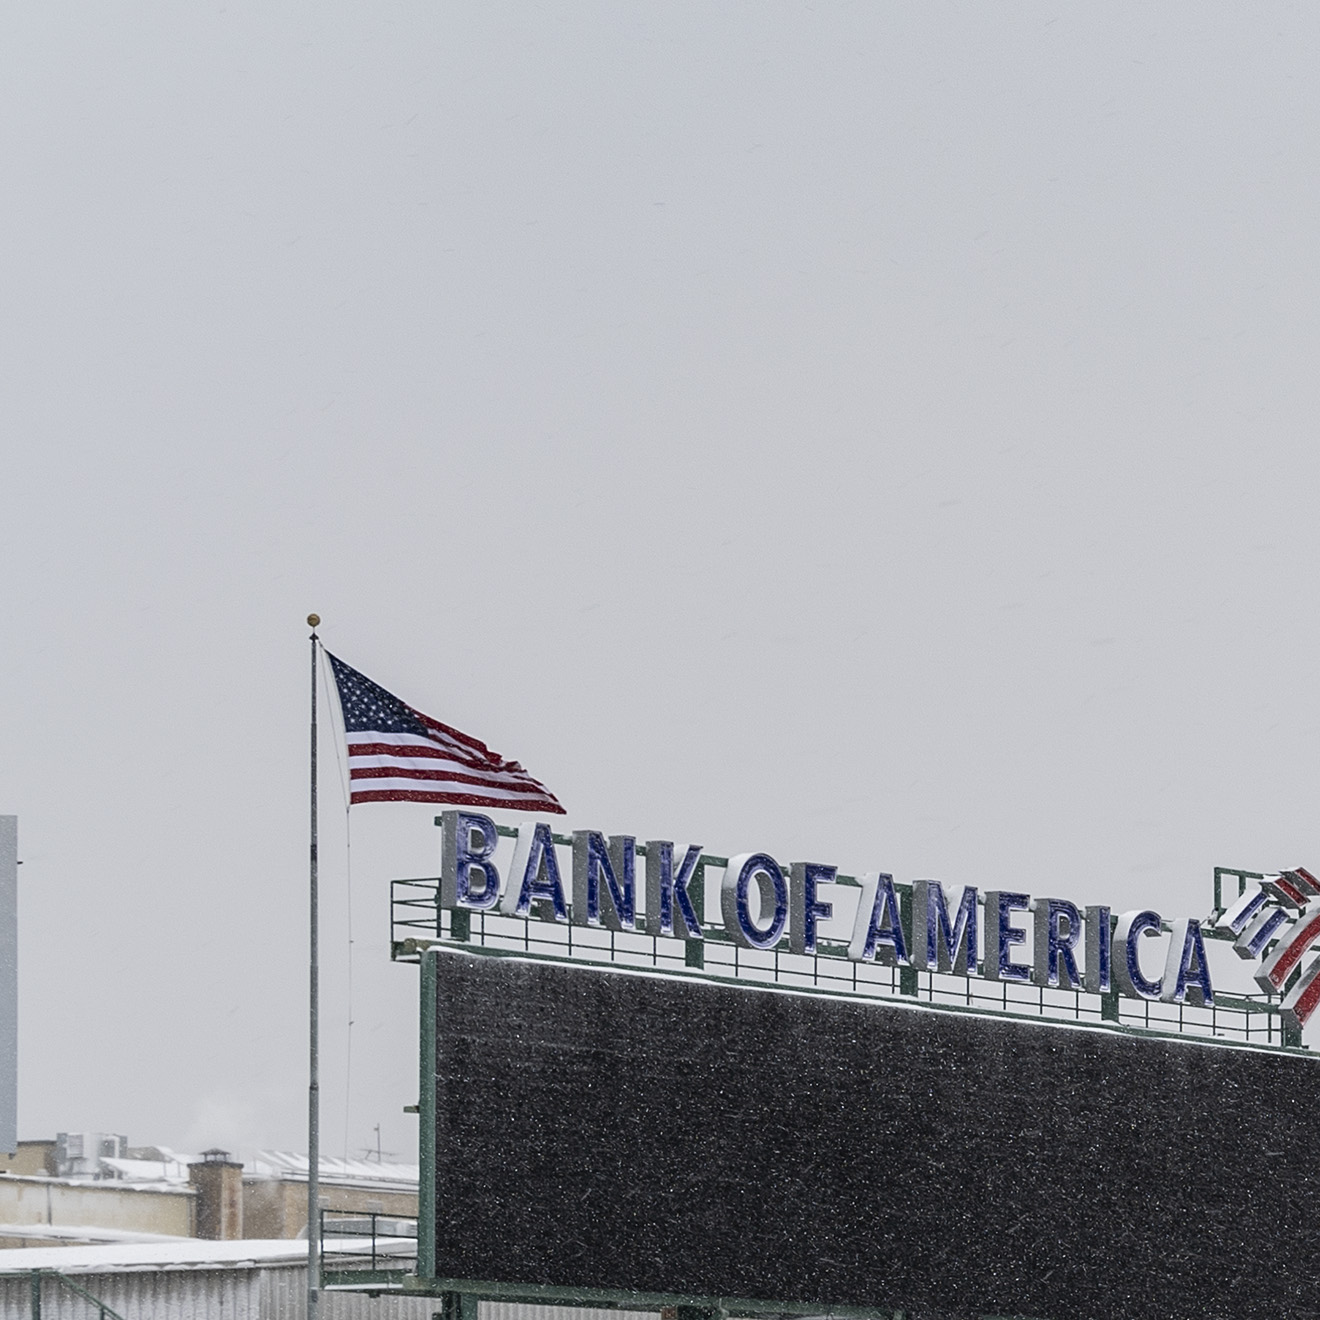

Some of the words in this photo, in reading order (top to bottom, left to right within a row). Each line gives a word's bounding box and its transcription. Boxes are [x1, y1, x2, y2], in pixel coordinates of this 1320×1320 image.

[441, 809, 704, 938] BANK
[721, 852, 838, 956] OF
[848, 871, 1216, 1007] AMERICA
